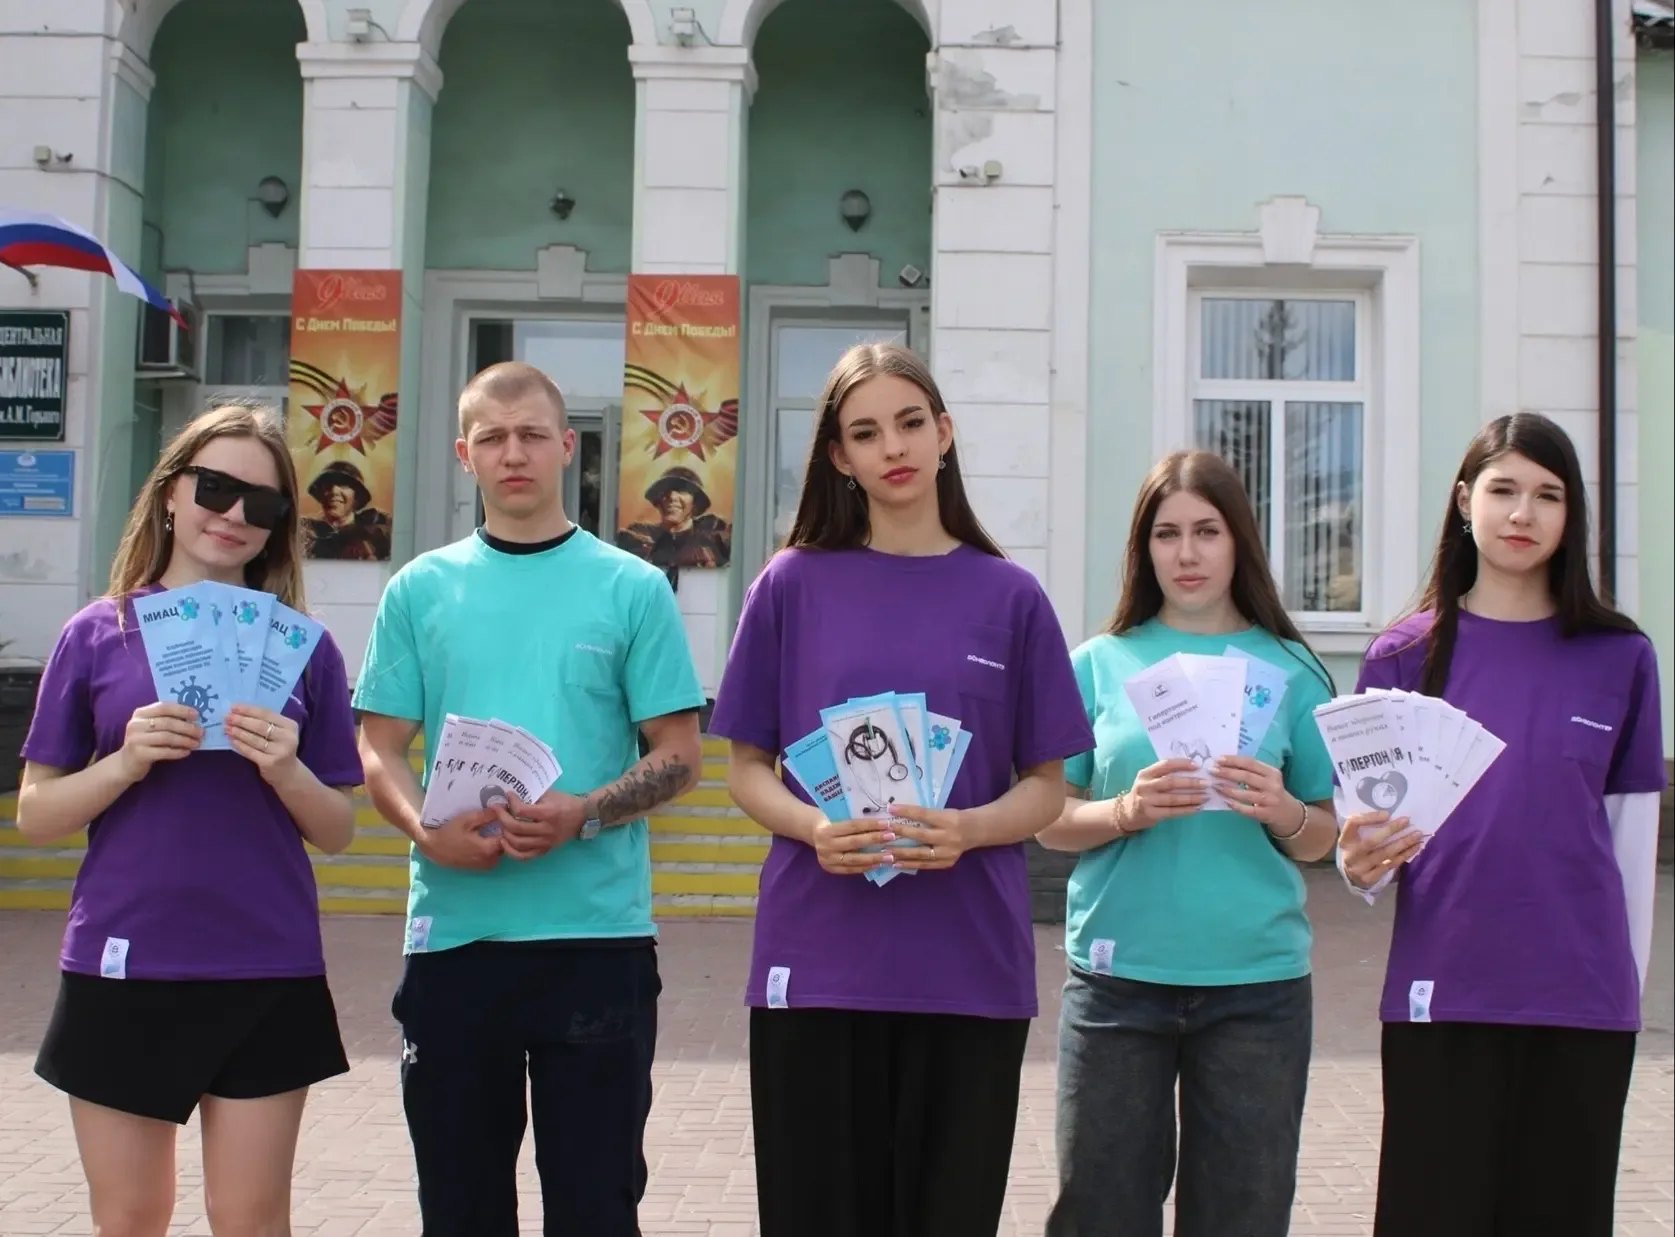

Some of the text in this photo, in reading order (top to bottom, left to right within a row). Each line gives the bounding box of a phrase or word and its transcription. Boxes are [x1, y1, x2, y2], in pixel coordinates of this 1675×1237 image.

[296, 317, 305, 331] С
[632, 321, 642, 336] С
[142, 606, 180, 623] МИАЦ
